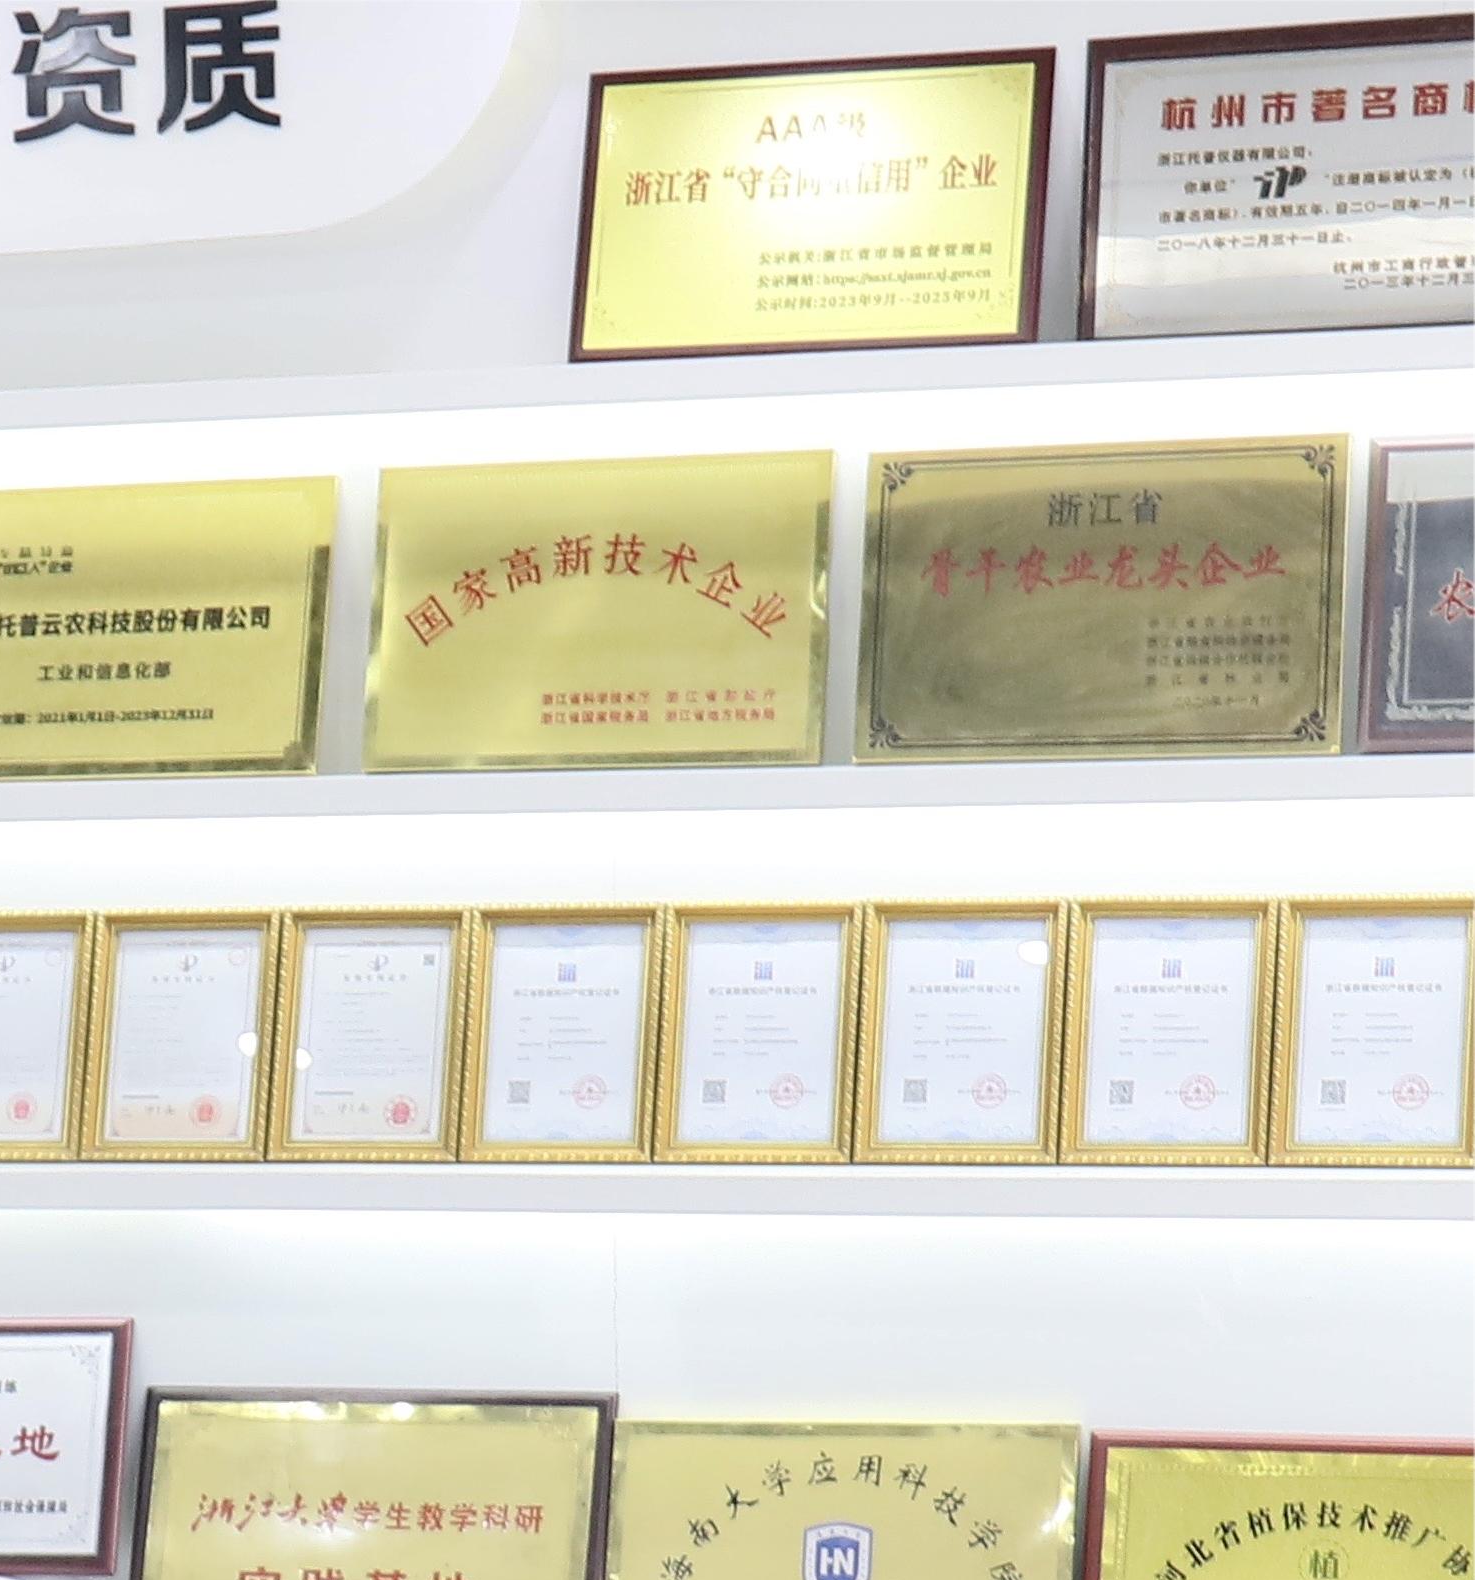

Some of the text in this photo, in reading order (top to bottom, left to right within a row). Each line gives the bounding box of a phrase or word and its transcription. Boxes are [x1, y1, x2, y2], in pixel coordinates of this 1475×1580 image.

[625, 154, 998, 207] 浙江省“守合同信用”企业
[1047, 489, 1164, 528] 浙江省
[404, 532, 787, 647] 国家高新技术企业
[37, 661, 173, 682] 工业和信息化部
